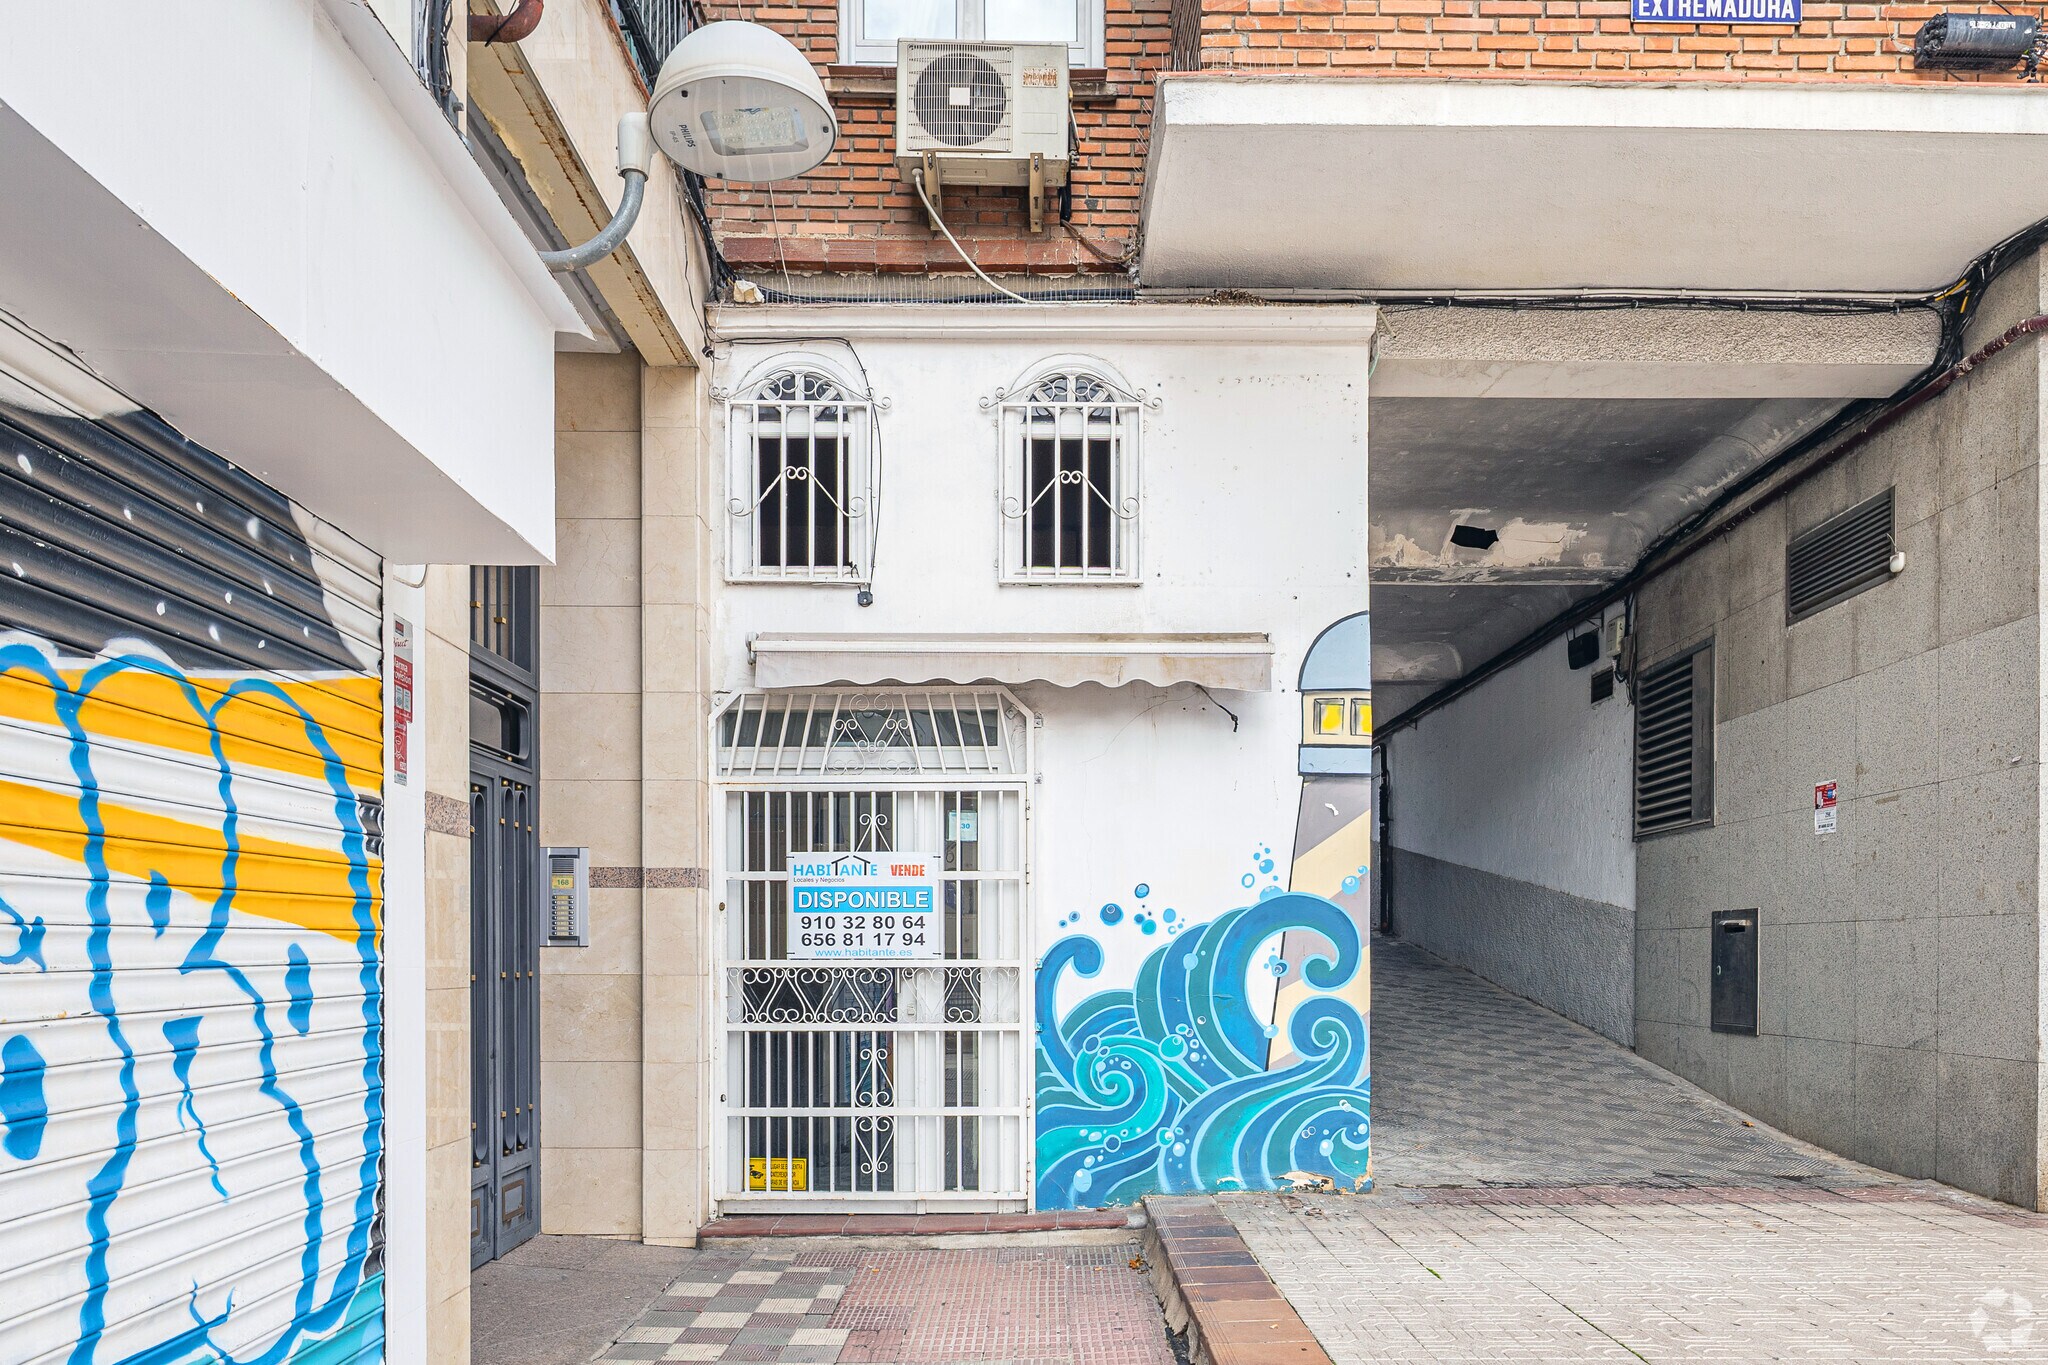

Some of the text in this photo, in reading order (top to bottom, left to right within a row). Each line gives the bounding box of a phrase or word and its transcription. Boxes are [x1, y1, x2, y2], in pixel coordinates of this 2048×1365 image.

[1638, 0, 1795, 18] EXTREMADURA
[679, 124, 696, 148] PHILIPS
[793, 855, 878, 876] HABITANTE
[890, 864, 925, 877] VENDE
[798, 891, 929, 908] DISPONIBLE
[801, 915, 925, 930] 910 32 80 64
[801, 933, 925, 947] 656 81 17 94
[815, 948, 913, 957] www.habitante.es
